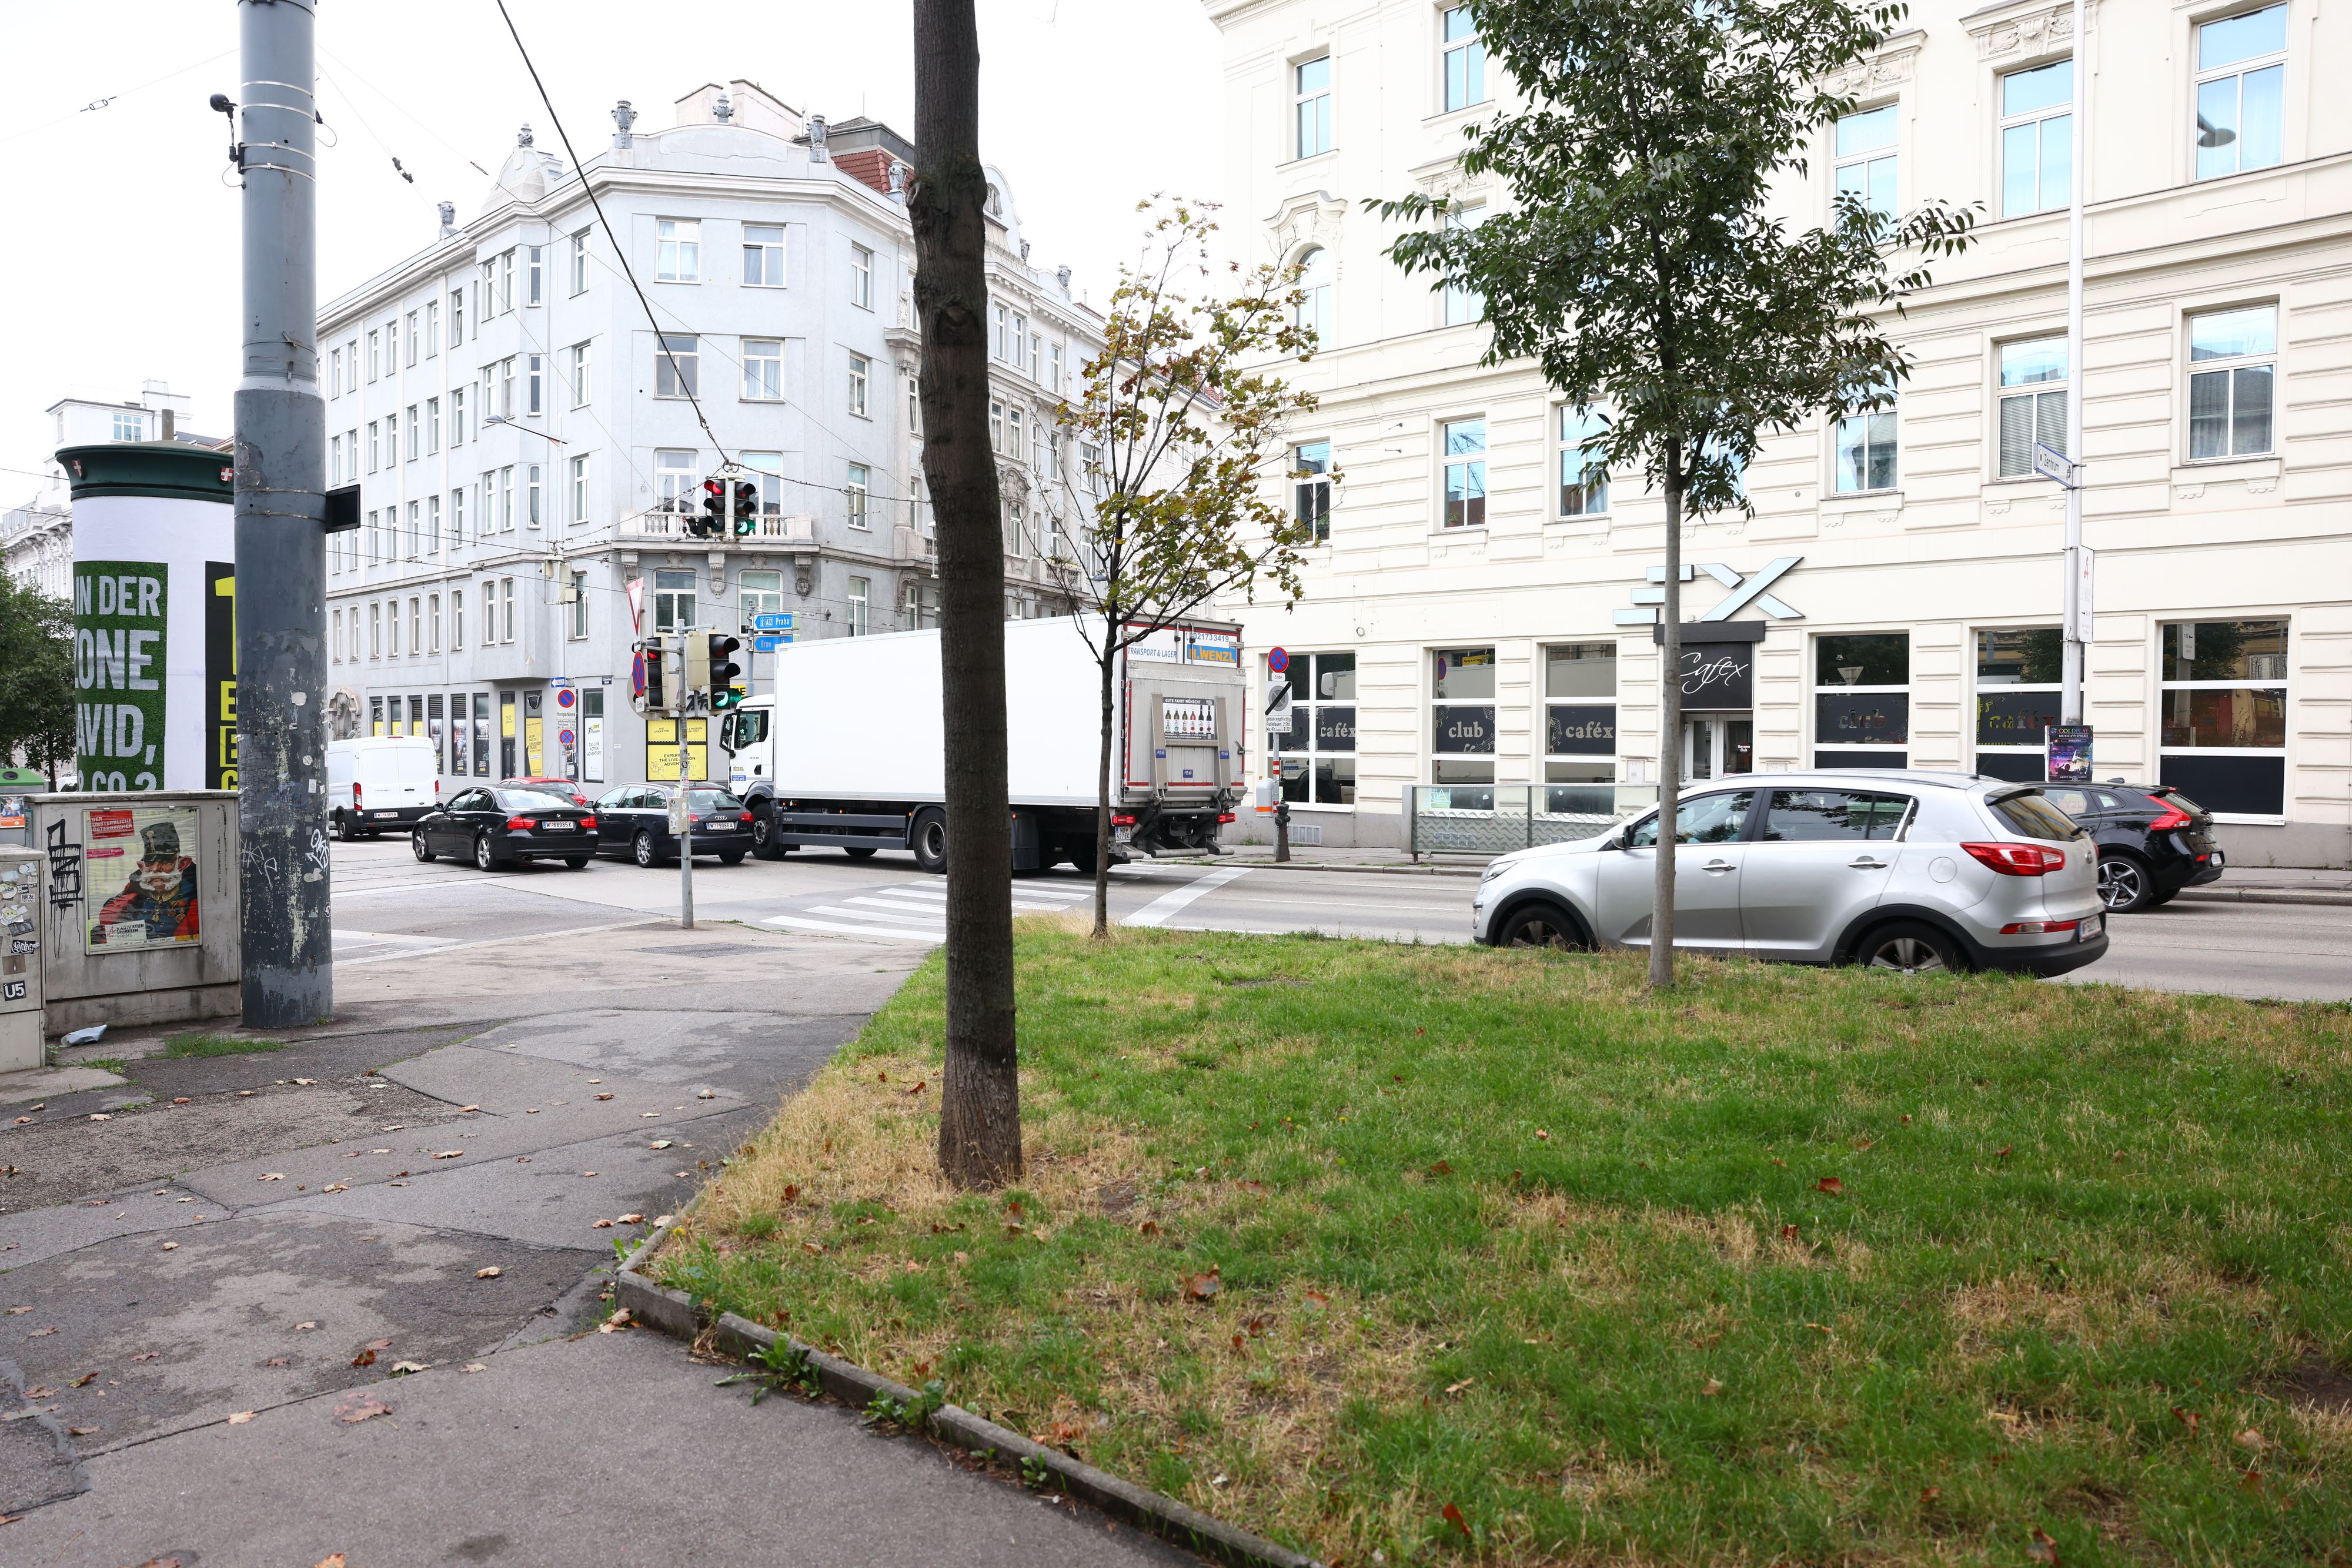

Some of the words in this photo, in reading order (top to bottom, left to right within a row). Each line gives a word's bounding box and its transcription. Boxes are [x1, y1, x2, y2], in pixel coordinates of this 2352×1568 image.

[2044, 453, 2060, 473] Zentrum
[99, 576, 161, 616] DER
[776, 617, 789, 626] Praha
[761, 640, 771, 648] Brno
[1128, 647, 1156, 657] TRANSPORT
[1161, 650, 1177, 658] LAGER
[1320, 722, 1355, 737] caféx
[1448, 721, 1484, 738] club
[1565, 721, 1613, 739] caféx
[92, 818, 132, 827] UNSTERBLICHE
